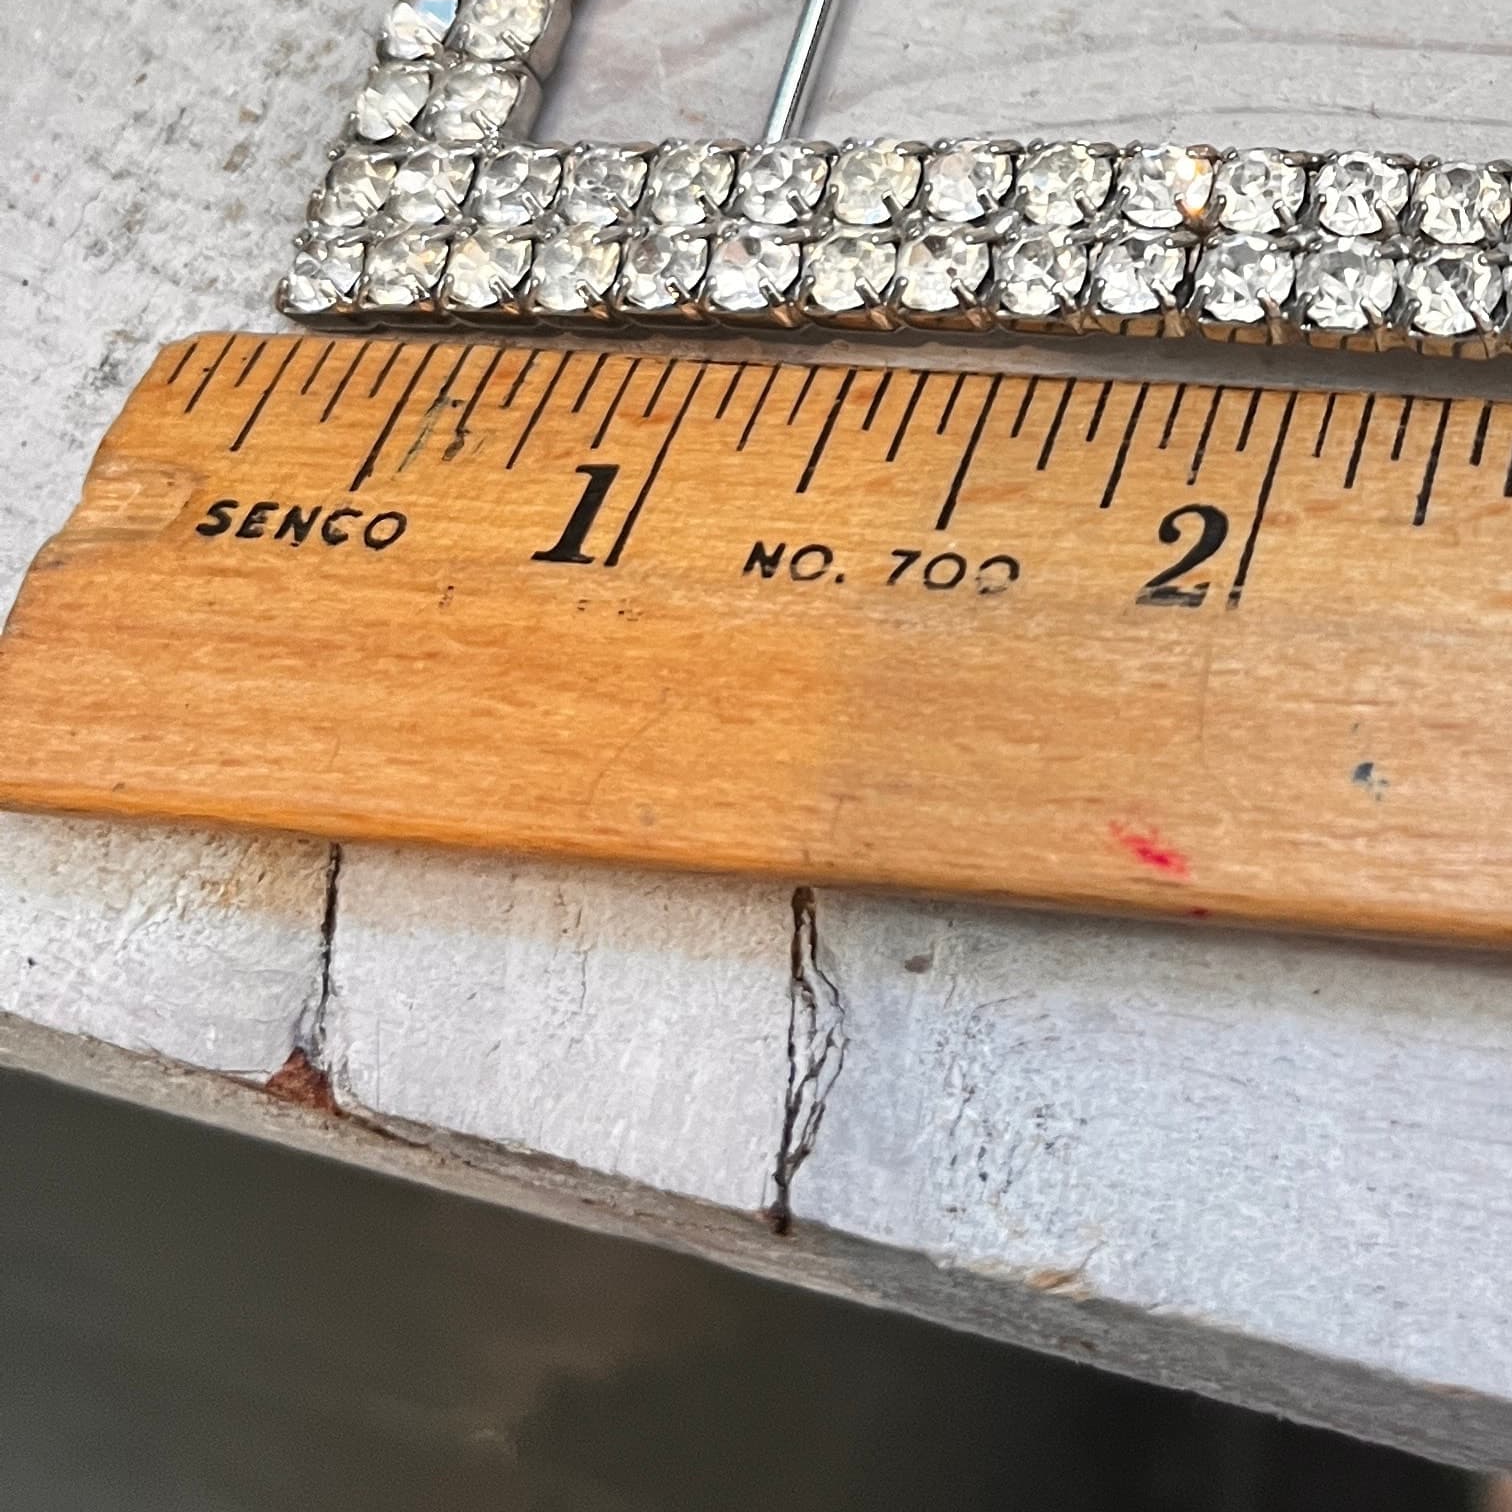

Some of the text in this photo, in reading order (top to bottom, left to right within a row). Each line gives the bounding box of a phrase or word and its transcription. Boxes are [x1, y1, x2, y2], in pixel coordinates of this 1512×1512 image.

[195, 498, 408, 550] SENCO
[530, 464, 621, 565] 1
[742, 541, 845, 584] NO.
[1135, 503, 1230, 607] 2
